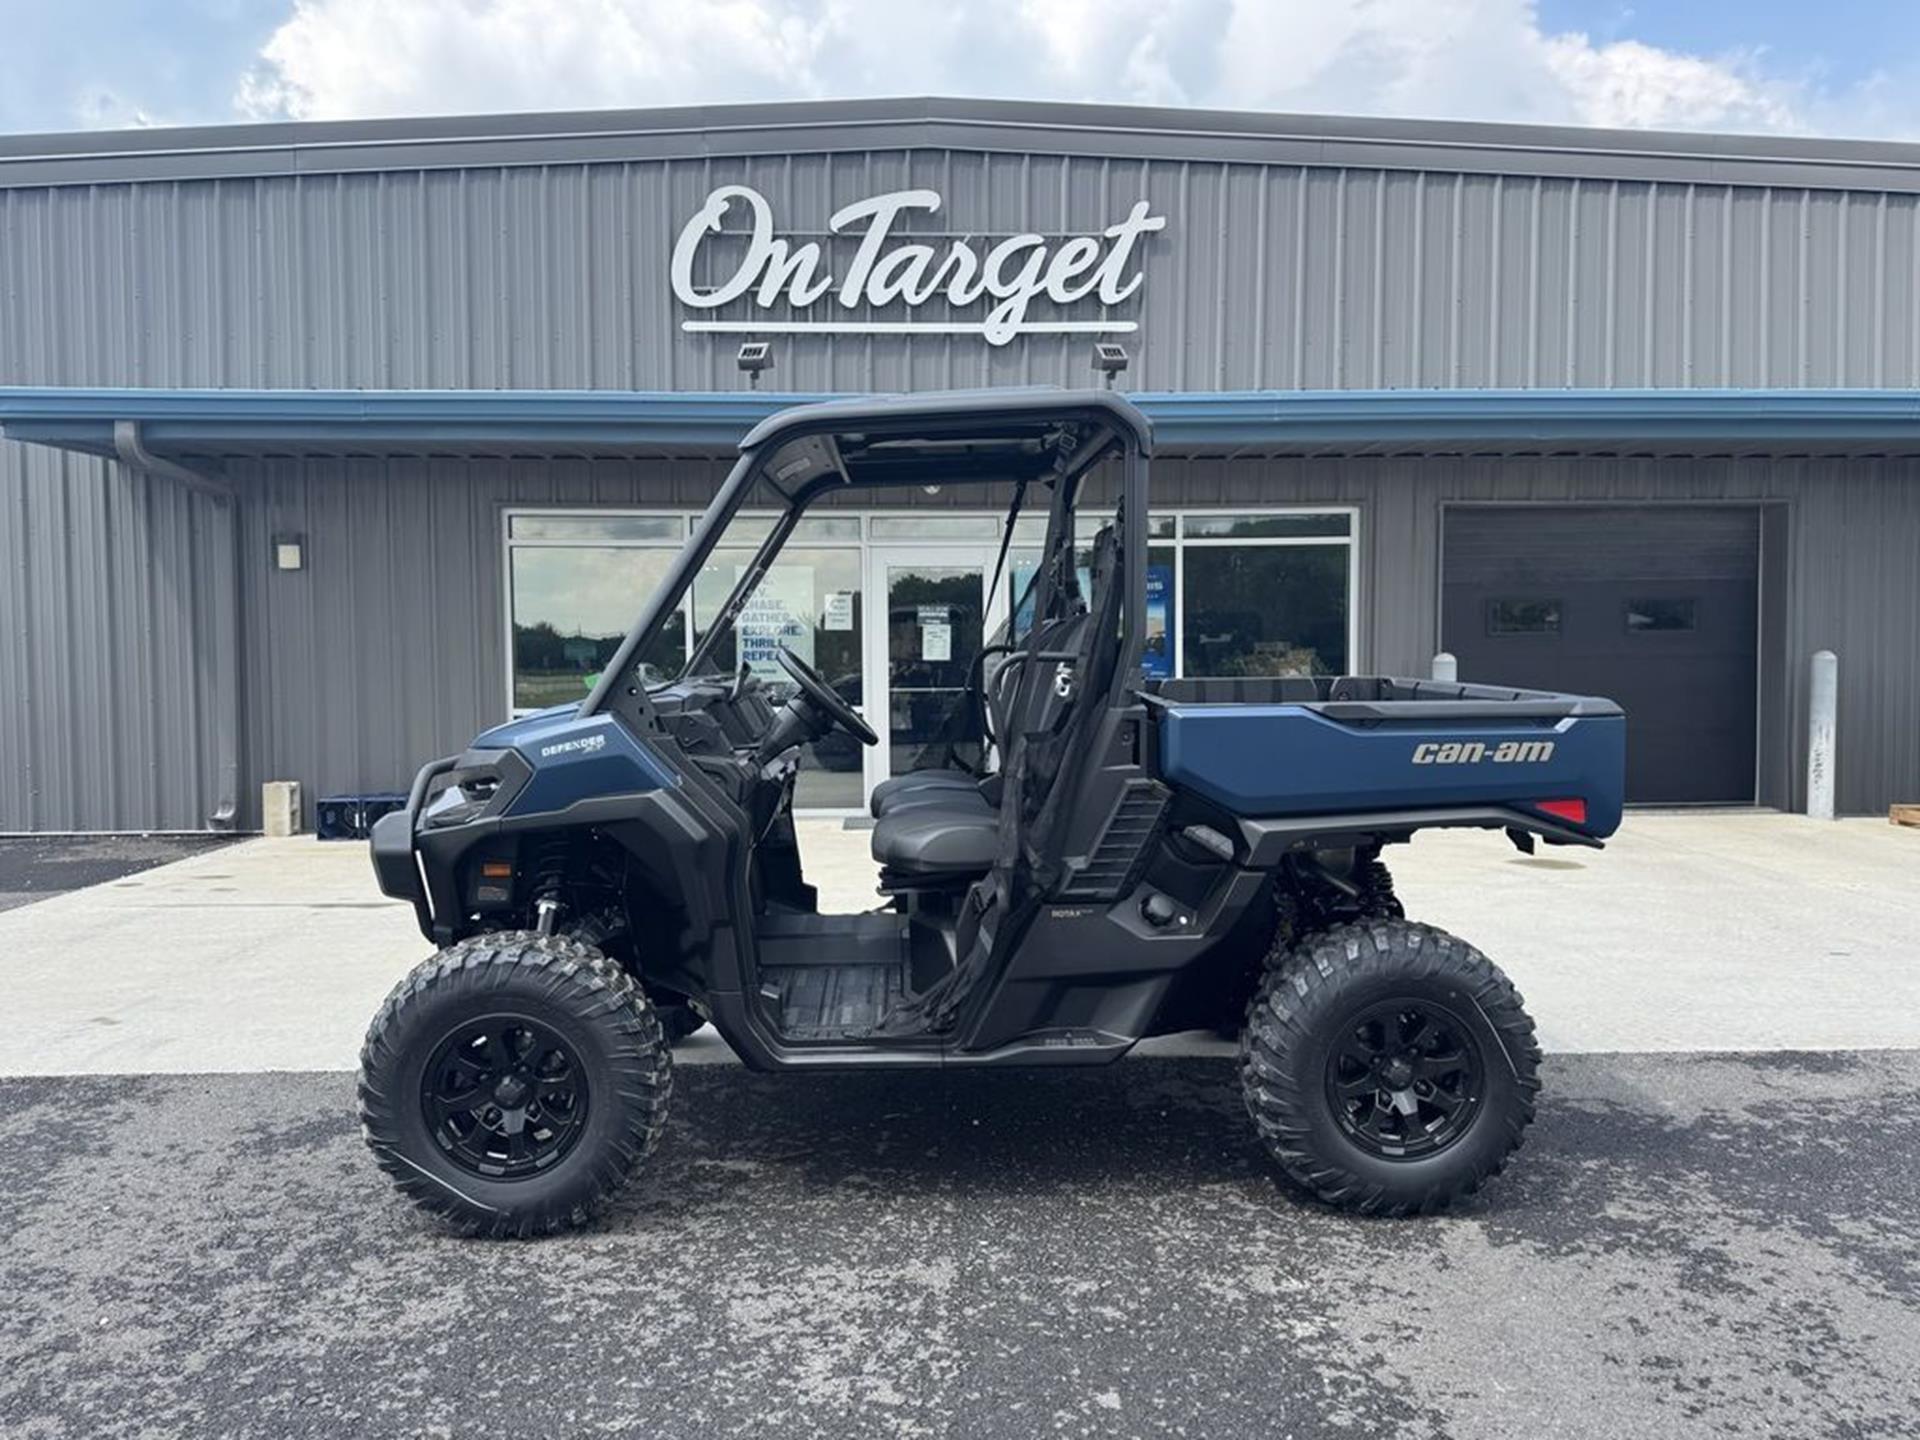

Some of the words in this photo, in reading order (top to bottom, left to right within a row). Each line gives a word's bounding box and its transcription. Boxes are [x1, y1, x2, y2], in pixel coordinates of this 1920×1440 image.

[829, 189, 1166, 346] Target
[742, 625, 802, 636] EXPLORE.
[541, 734, 605, 757] DEFENDER
[1411, 741, 1555, 764] can-am
